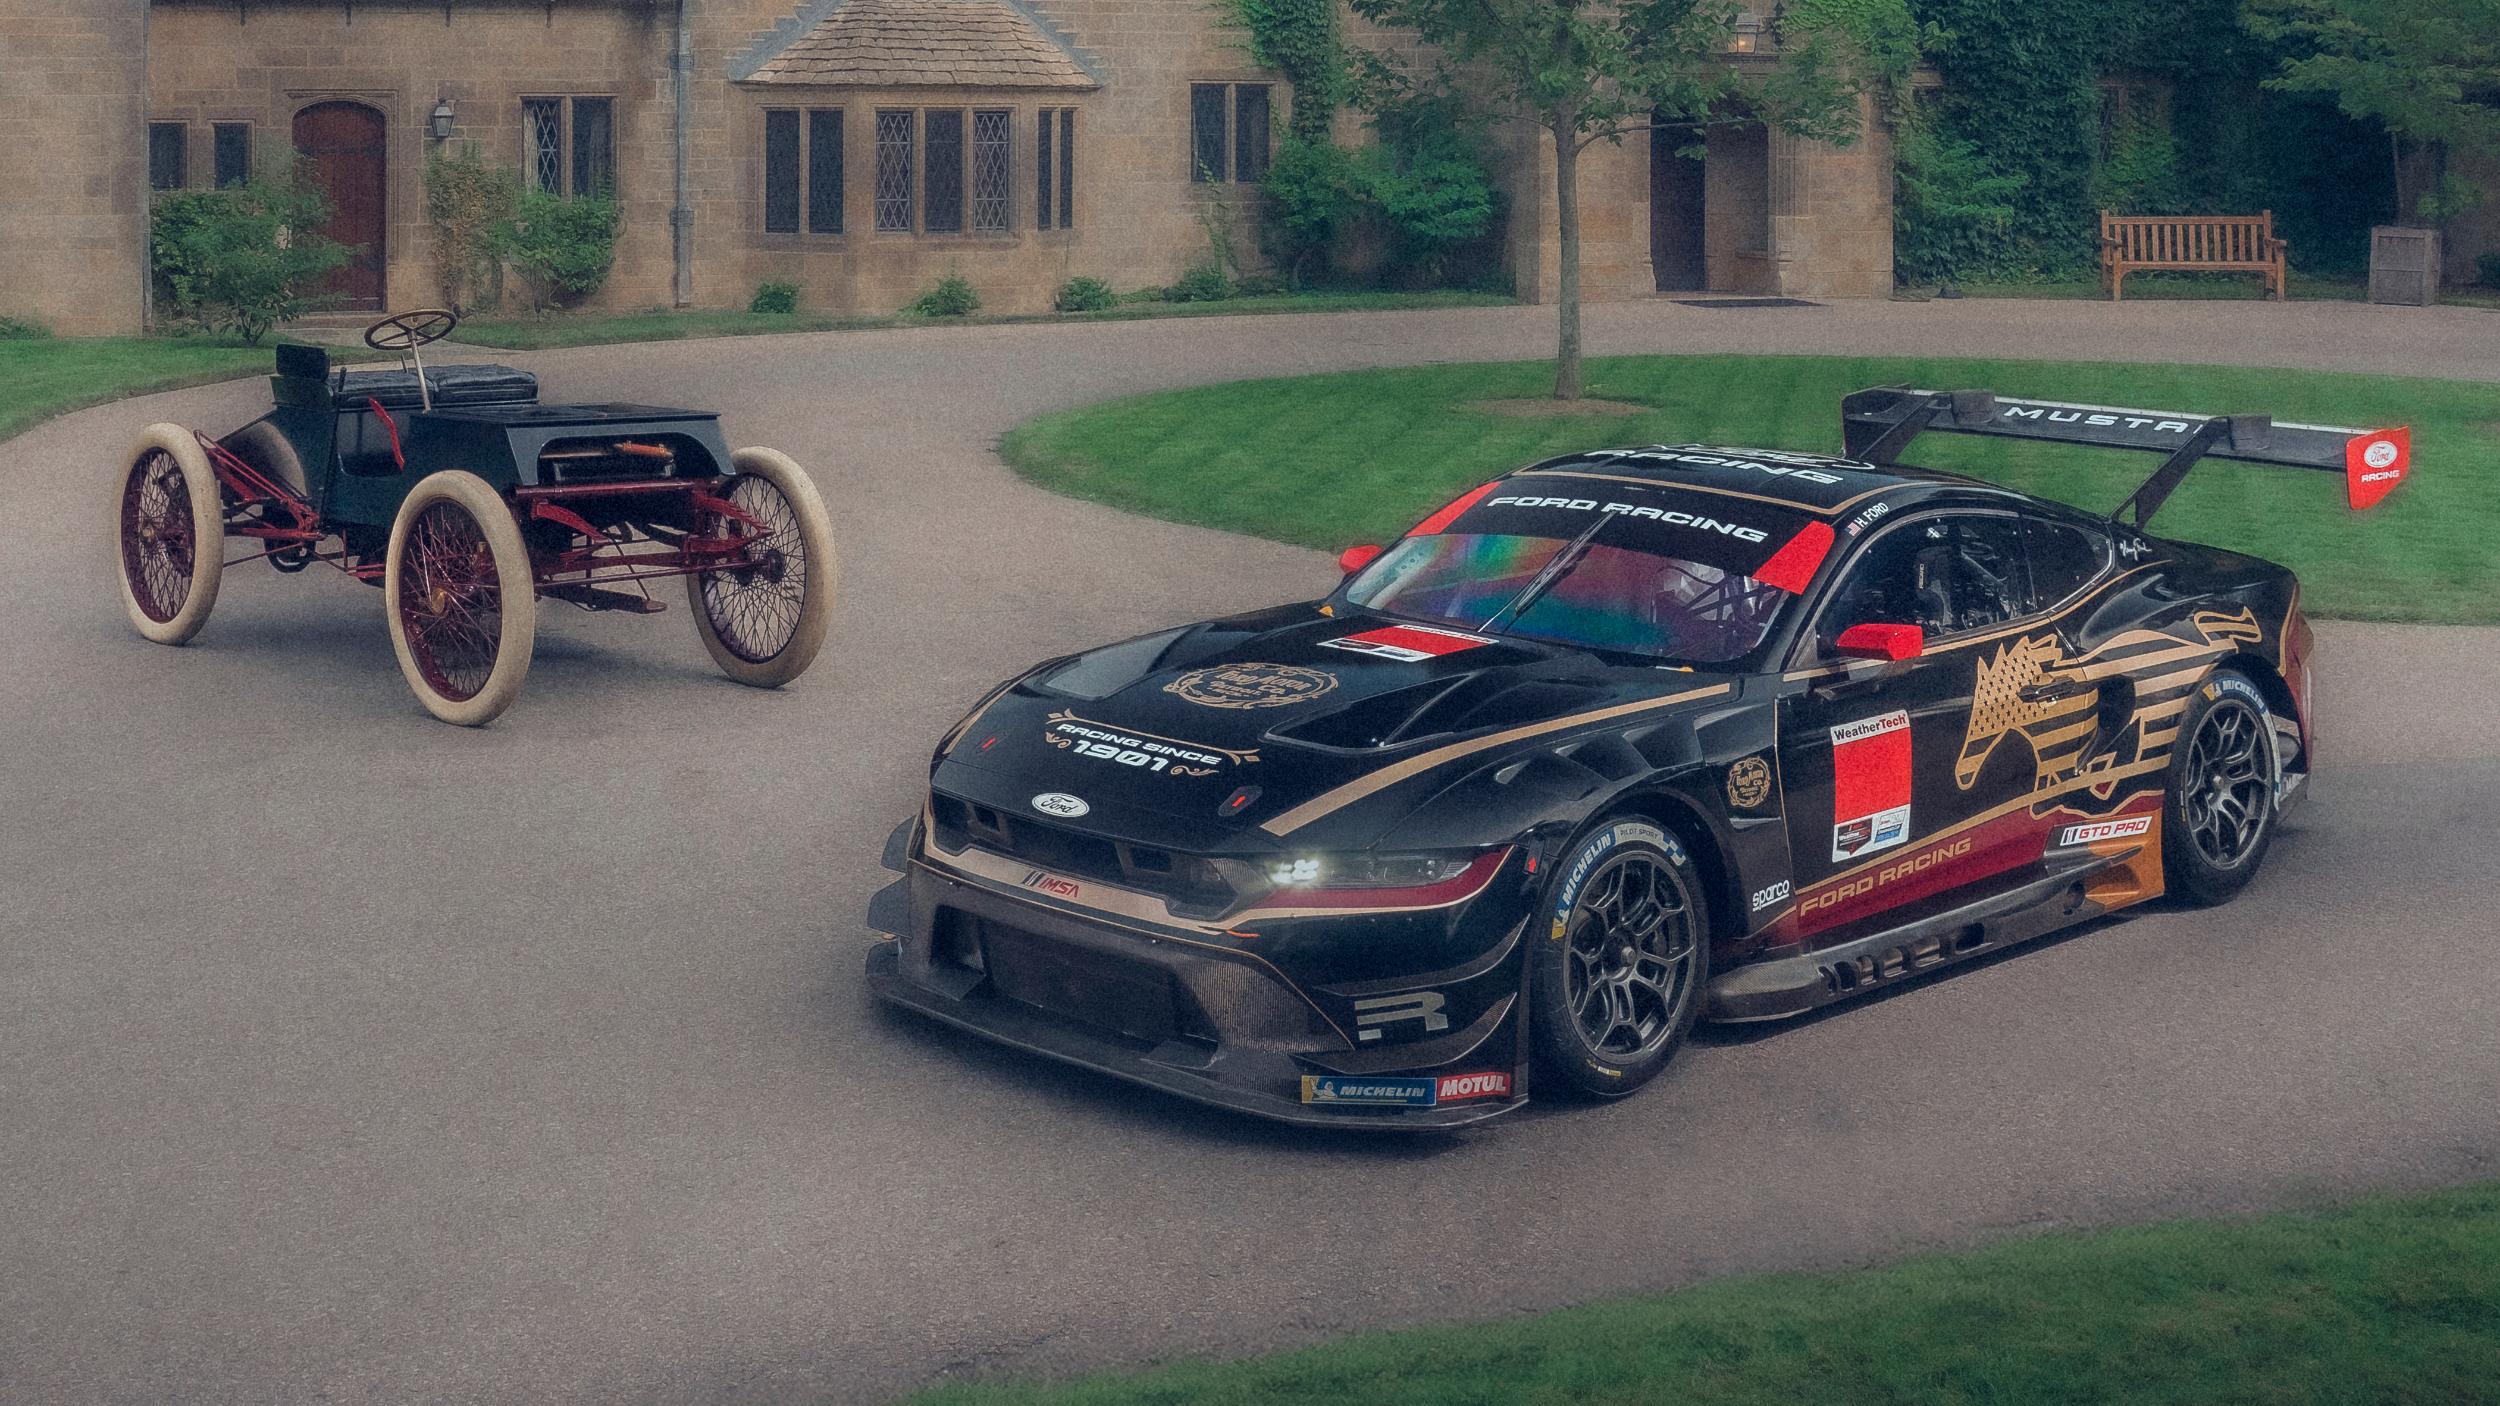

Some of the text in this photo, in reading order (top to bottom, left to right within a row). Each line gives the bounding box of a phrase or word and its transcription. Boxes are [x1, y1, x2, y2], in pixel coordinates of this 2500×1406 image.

[2003, 406, 2203, 435] MUSTA
[1583, 450, 1844, 485] RACING
[2361, 469, 2400, 483] RACING
[1487, 496, 1769, 543] FORD RACING
[1862, 502, 1889, 522] FORD
[2222, 679, 2265, 709] MICHELIN
[1833, 713, 1906, 741] WeatherTech
[1056, 723, 1223, 766] RACING SINCE
[1073, 739, 1170, 772] 1901
[1041, 795, 1079, 815] Ford
[2078, 820, 2147, 839] GTD PRO
[1561, 833, 1612, 905] MICHELIN
[1800, 837, 1972, 918] FORD RACING
[1038, 876, 1080, 898] IMSA
[1753, 879, 1791, 911] sparco
[1339, 1085, 1426, 1098] MICHELIN
[1440, 1075, 1507, 1098] MOTUL
